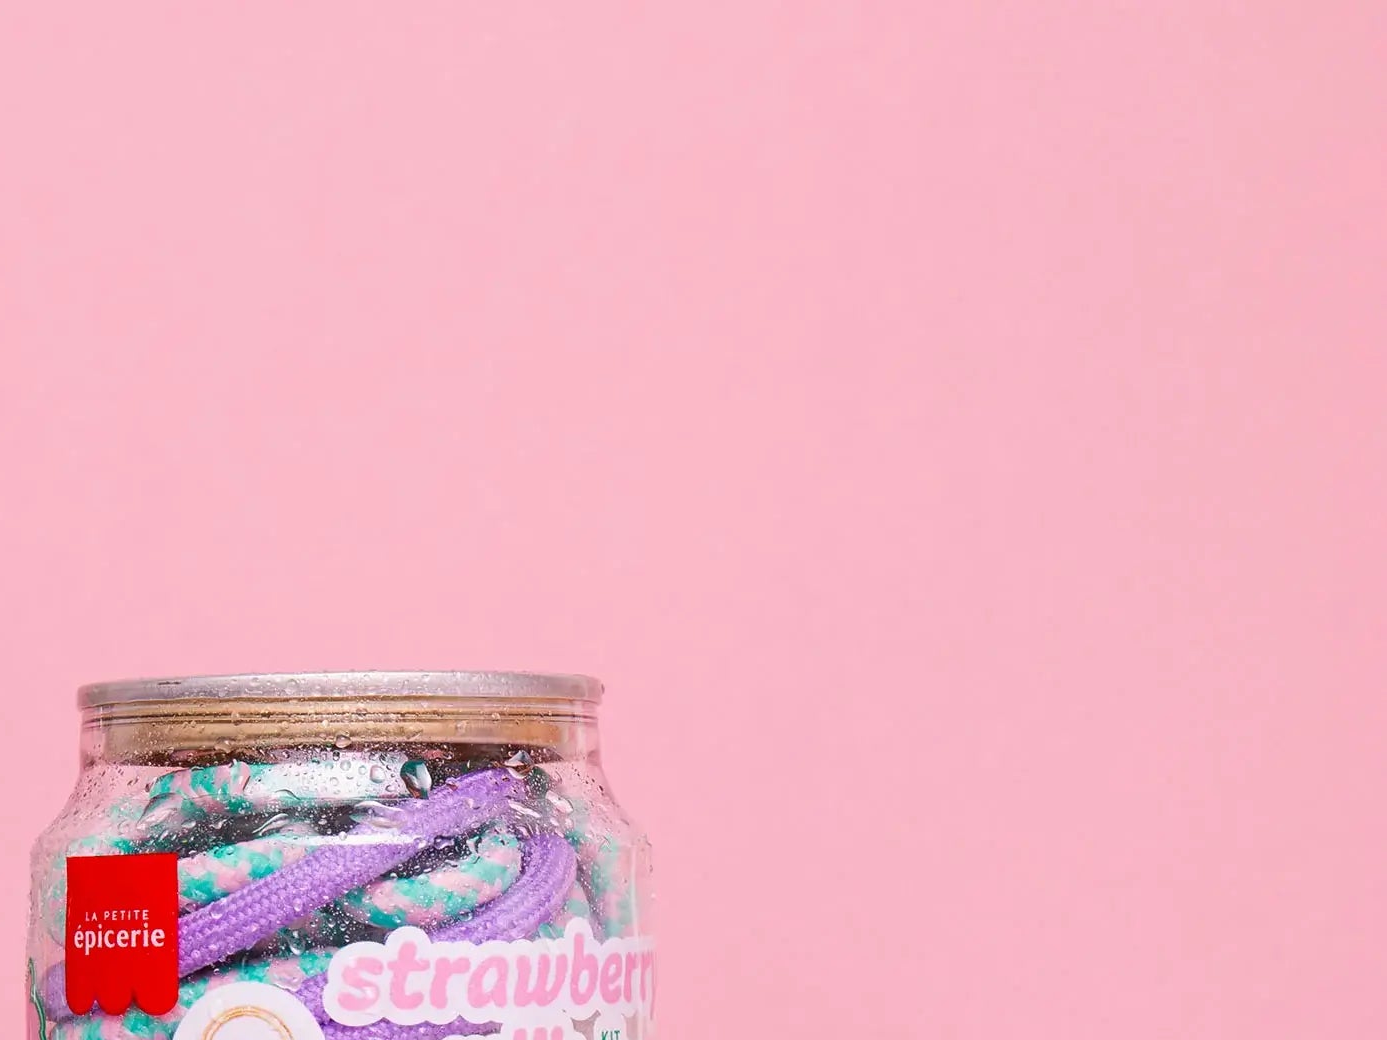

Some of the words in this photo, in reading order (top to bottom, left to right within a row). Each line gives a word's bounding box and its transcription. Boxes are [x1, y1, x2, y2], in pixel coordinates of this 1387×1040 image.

[85, 911, 98, 922] LA
[103, 909, 150, 921] PETITE
[73, 922, 166, 956] épicerie
